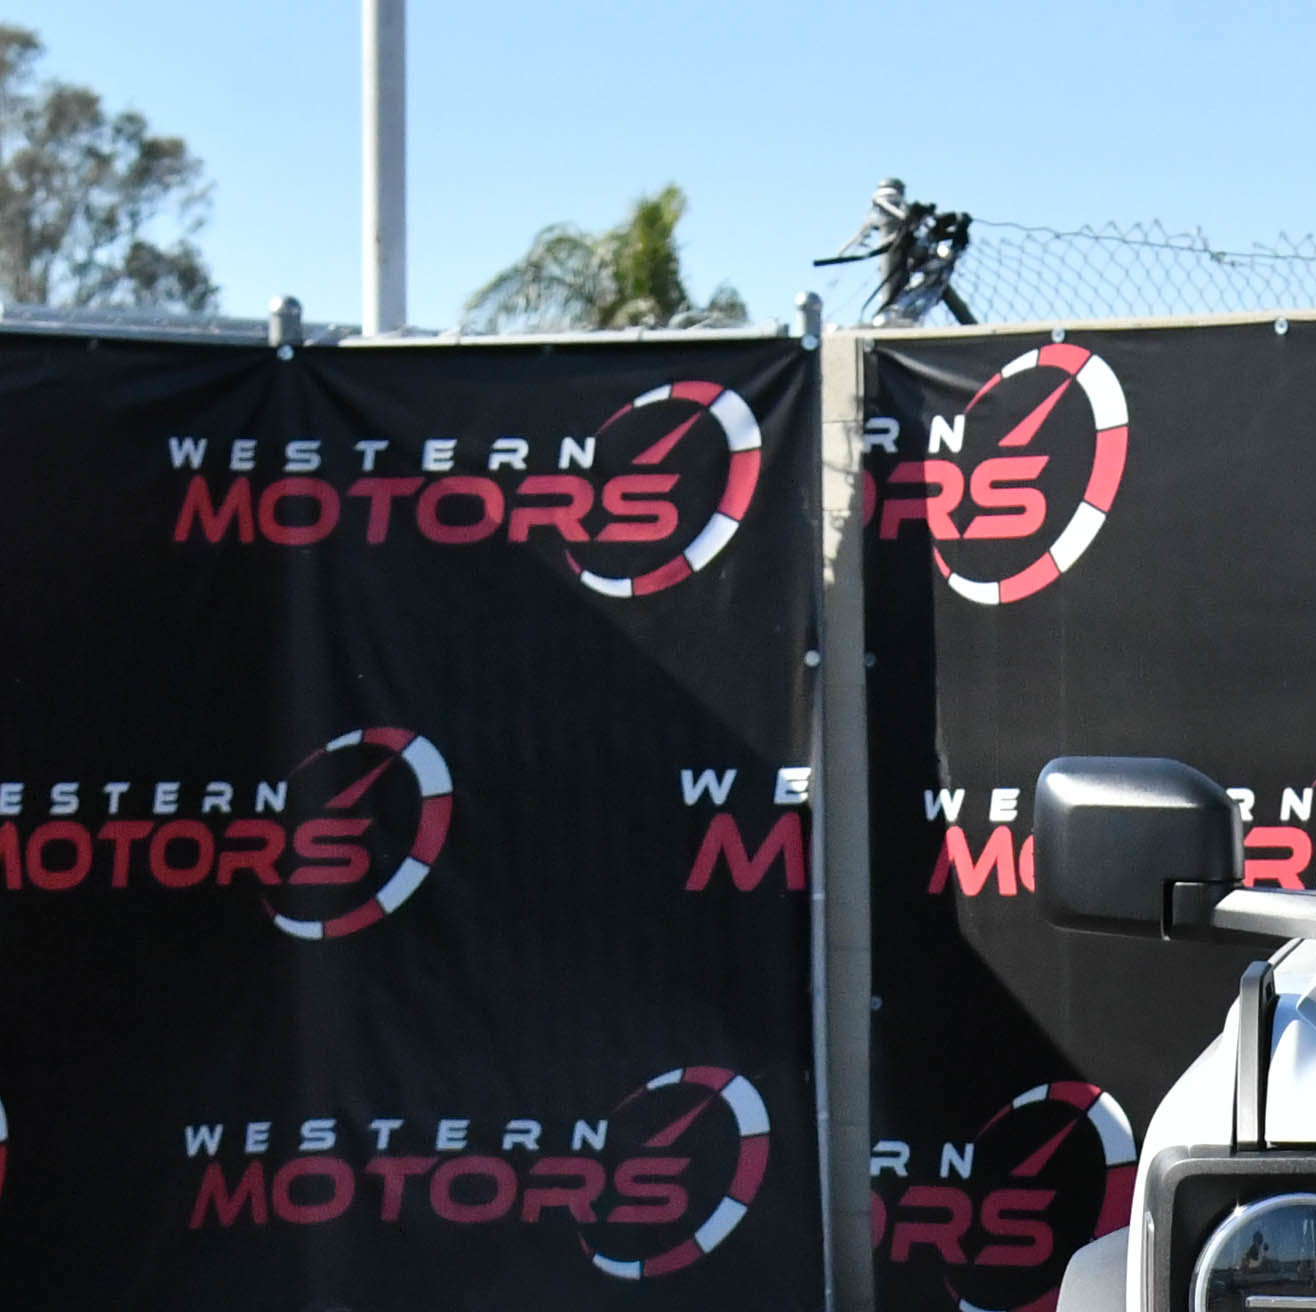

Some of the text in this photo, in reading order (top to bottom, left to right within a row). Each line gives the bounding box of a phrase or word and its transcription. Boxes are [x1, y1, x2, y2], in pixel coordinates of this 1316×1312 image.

[170, 436, 596, 472] WESTERN
[173, 473, 680, 546] MOTORS
[185, 1119, 608, 1157] WESTERN
[189, 1156, 691, 1229] MOTORS
